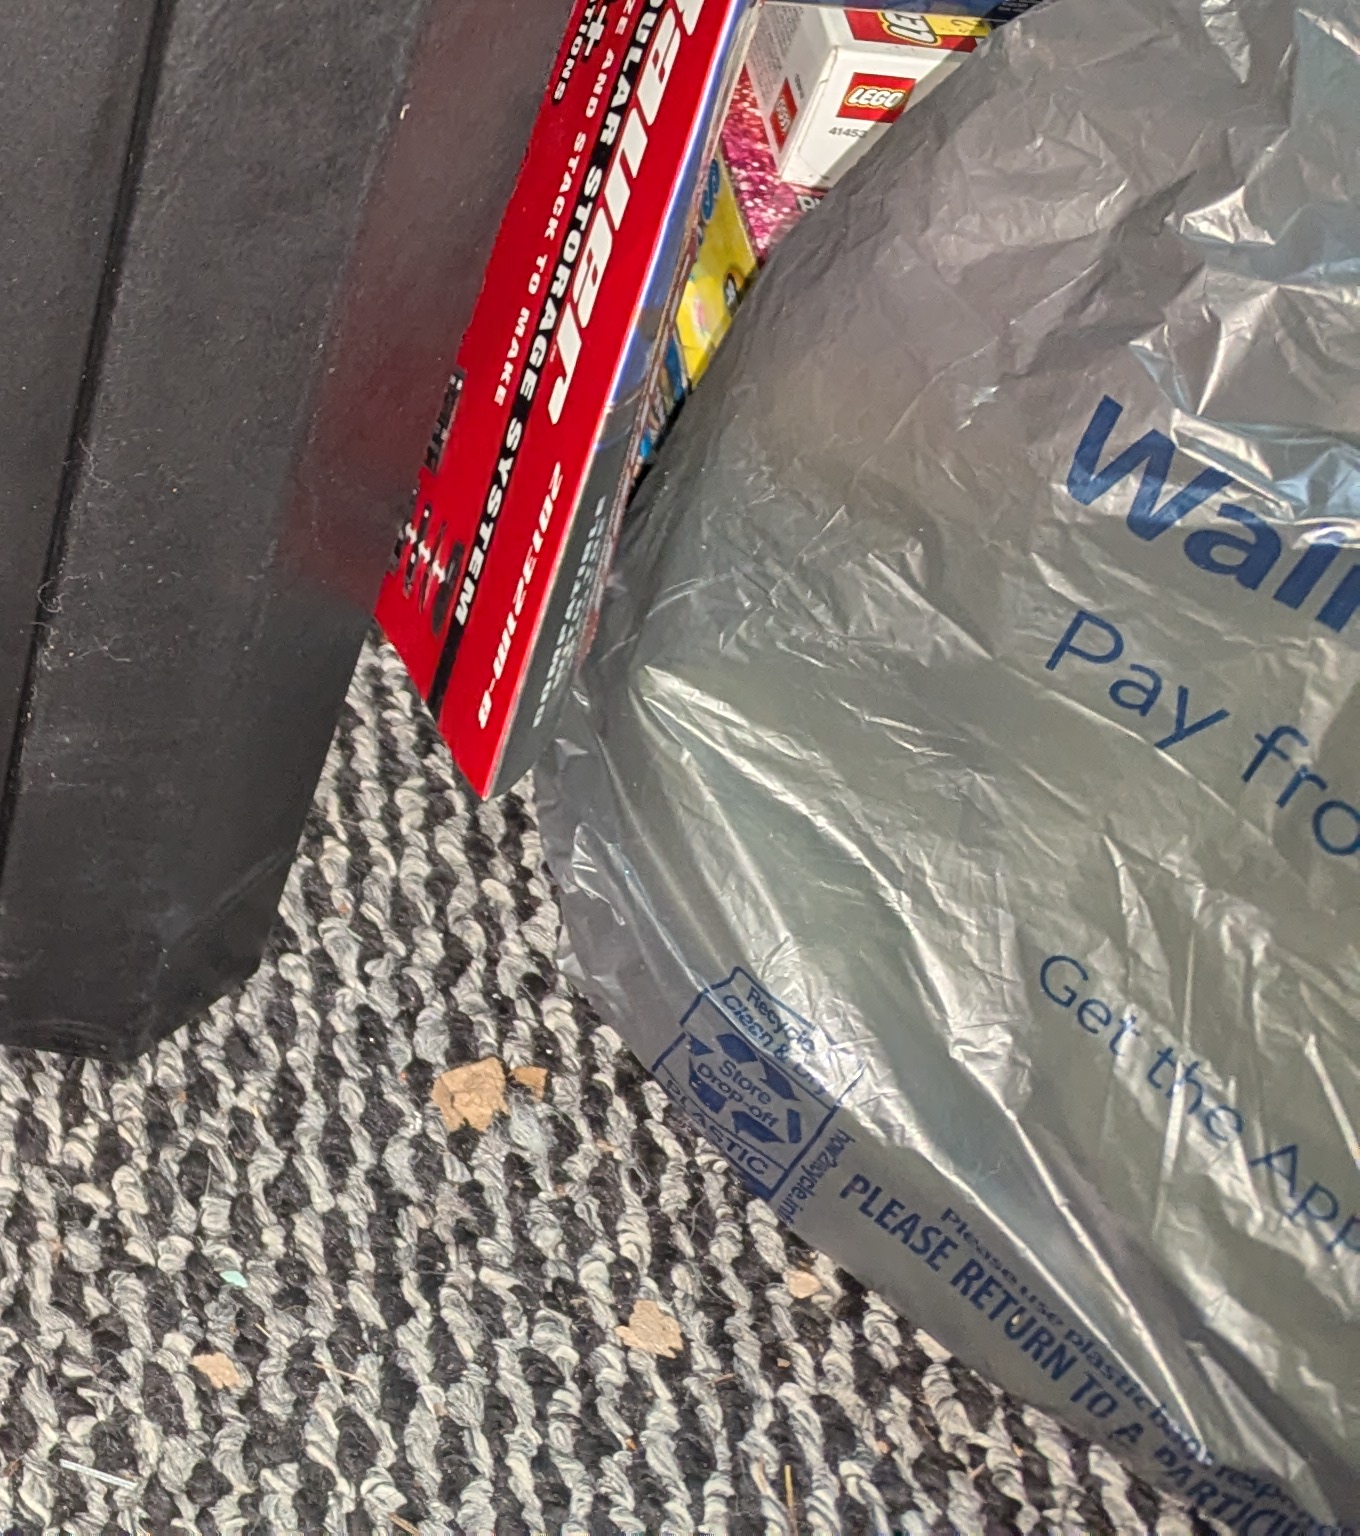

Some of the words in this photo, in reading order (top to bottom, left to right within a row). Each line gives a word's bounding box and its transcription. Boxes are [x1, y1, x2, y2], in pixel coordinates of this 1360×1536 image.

[585, 48, 615, 119] AND
[845, 85, 906, 110] LEGO
[829, 127, 867, 139] 41453
[543, 131, 586, 241] STACK
[520, 165, 604, 402] STORAGE
[528, 254, 548, 295] TO
[494, 307, 530, 406] MAKE
[454, 417, 523, 626] SYSTEM
[1044, 609, 1229, 751] Pay
[723, 994, 774, 1048] Clean
[747, 986, 816, 1053] Recycle
[1040, 955, 1141, 1057] Get
[1147, 1046, 1244, 1143] the
[697, 1063, 780, 1128] Drop-off
[719, 1060, 772, 1105] Store
[840, 1174, 959, 1272] PLEASE
[949, 1258, 1078, 1381] RETURN
[1070, 1373, 1119, 1419] TO
[1108, 1422, 1145, 1444] A
[940, 1208, 1018, 1284] Please
[1020, 1286, 1064, 1327] use
[1064, 1329, 1150, 1411] plastic
